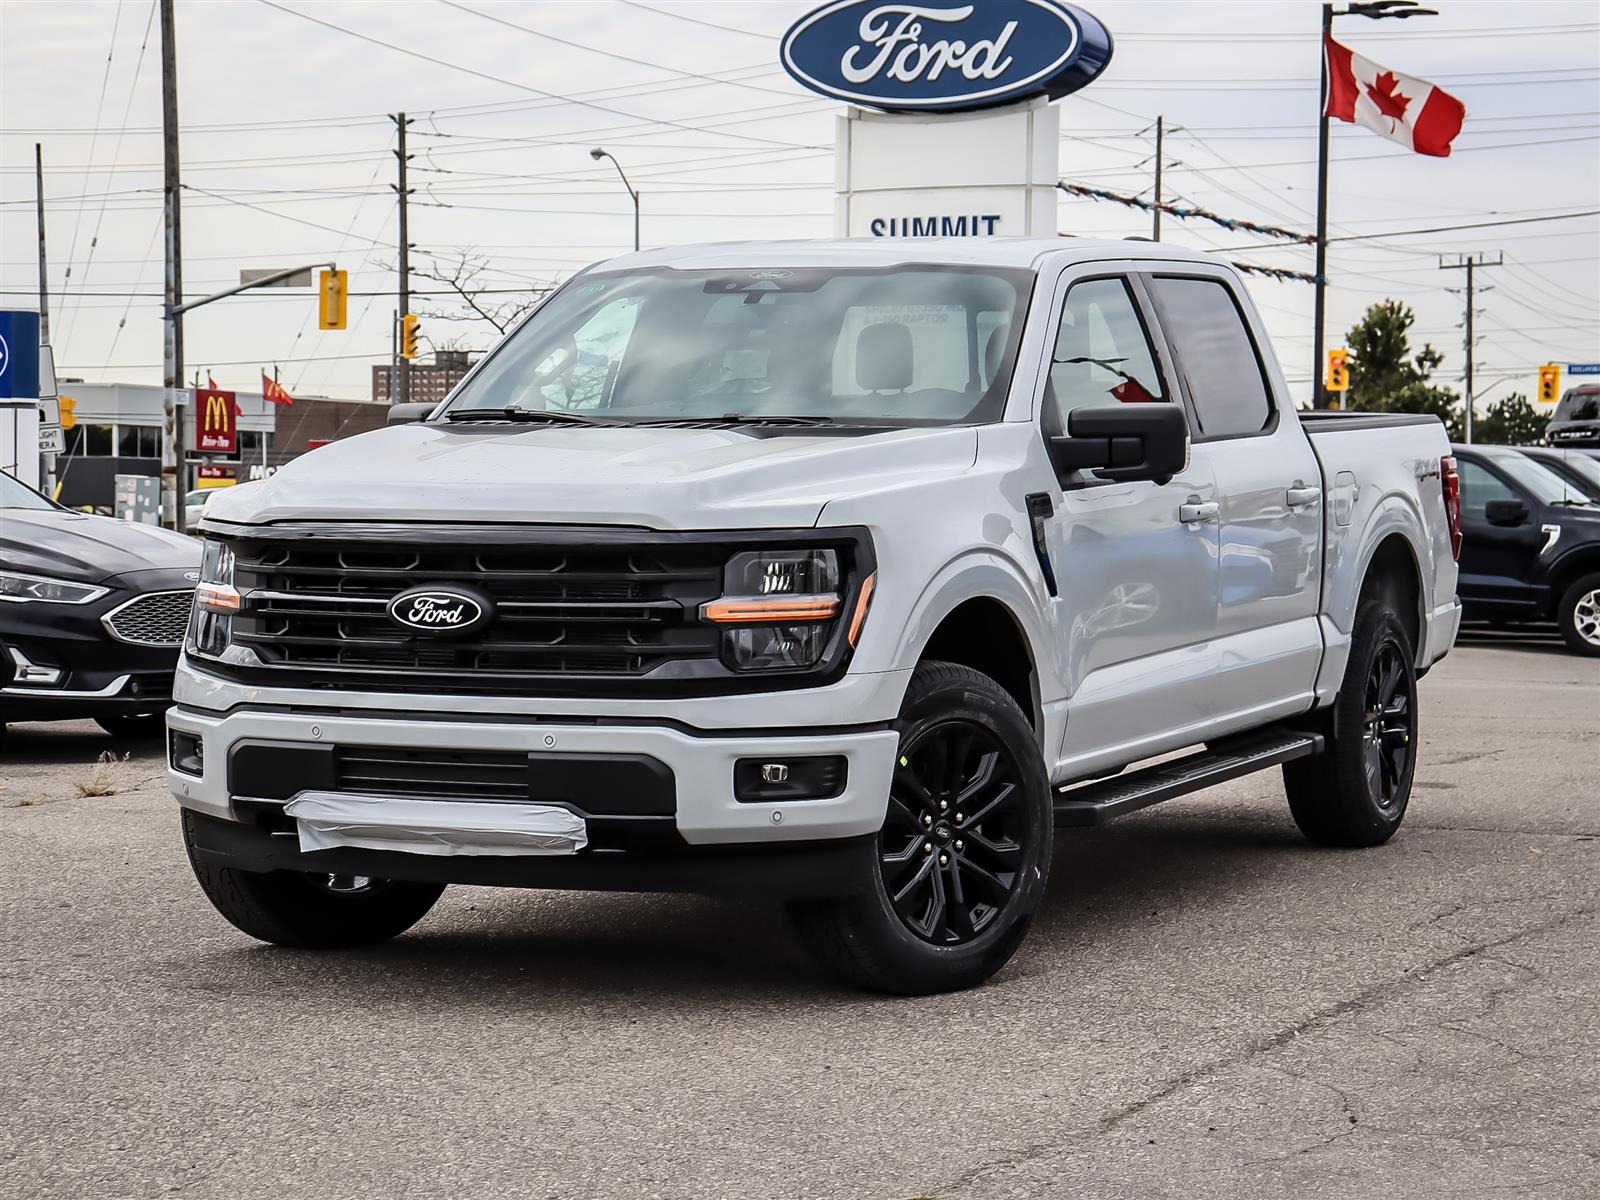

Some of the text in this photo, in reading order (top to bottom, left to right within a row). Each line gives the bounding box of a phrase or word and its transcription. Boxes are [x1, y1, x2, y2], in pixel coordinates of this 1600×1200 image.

[840, 4, 1019, 84] Ford
[870, 215, 1001, 237] SUMMIT
[902, 313, 949, 324] RAPTOR
[408, 596, 463, 624] Ford
